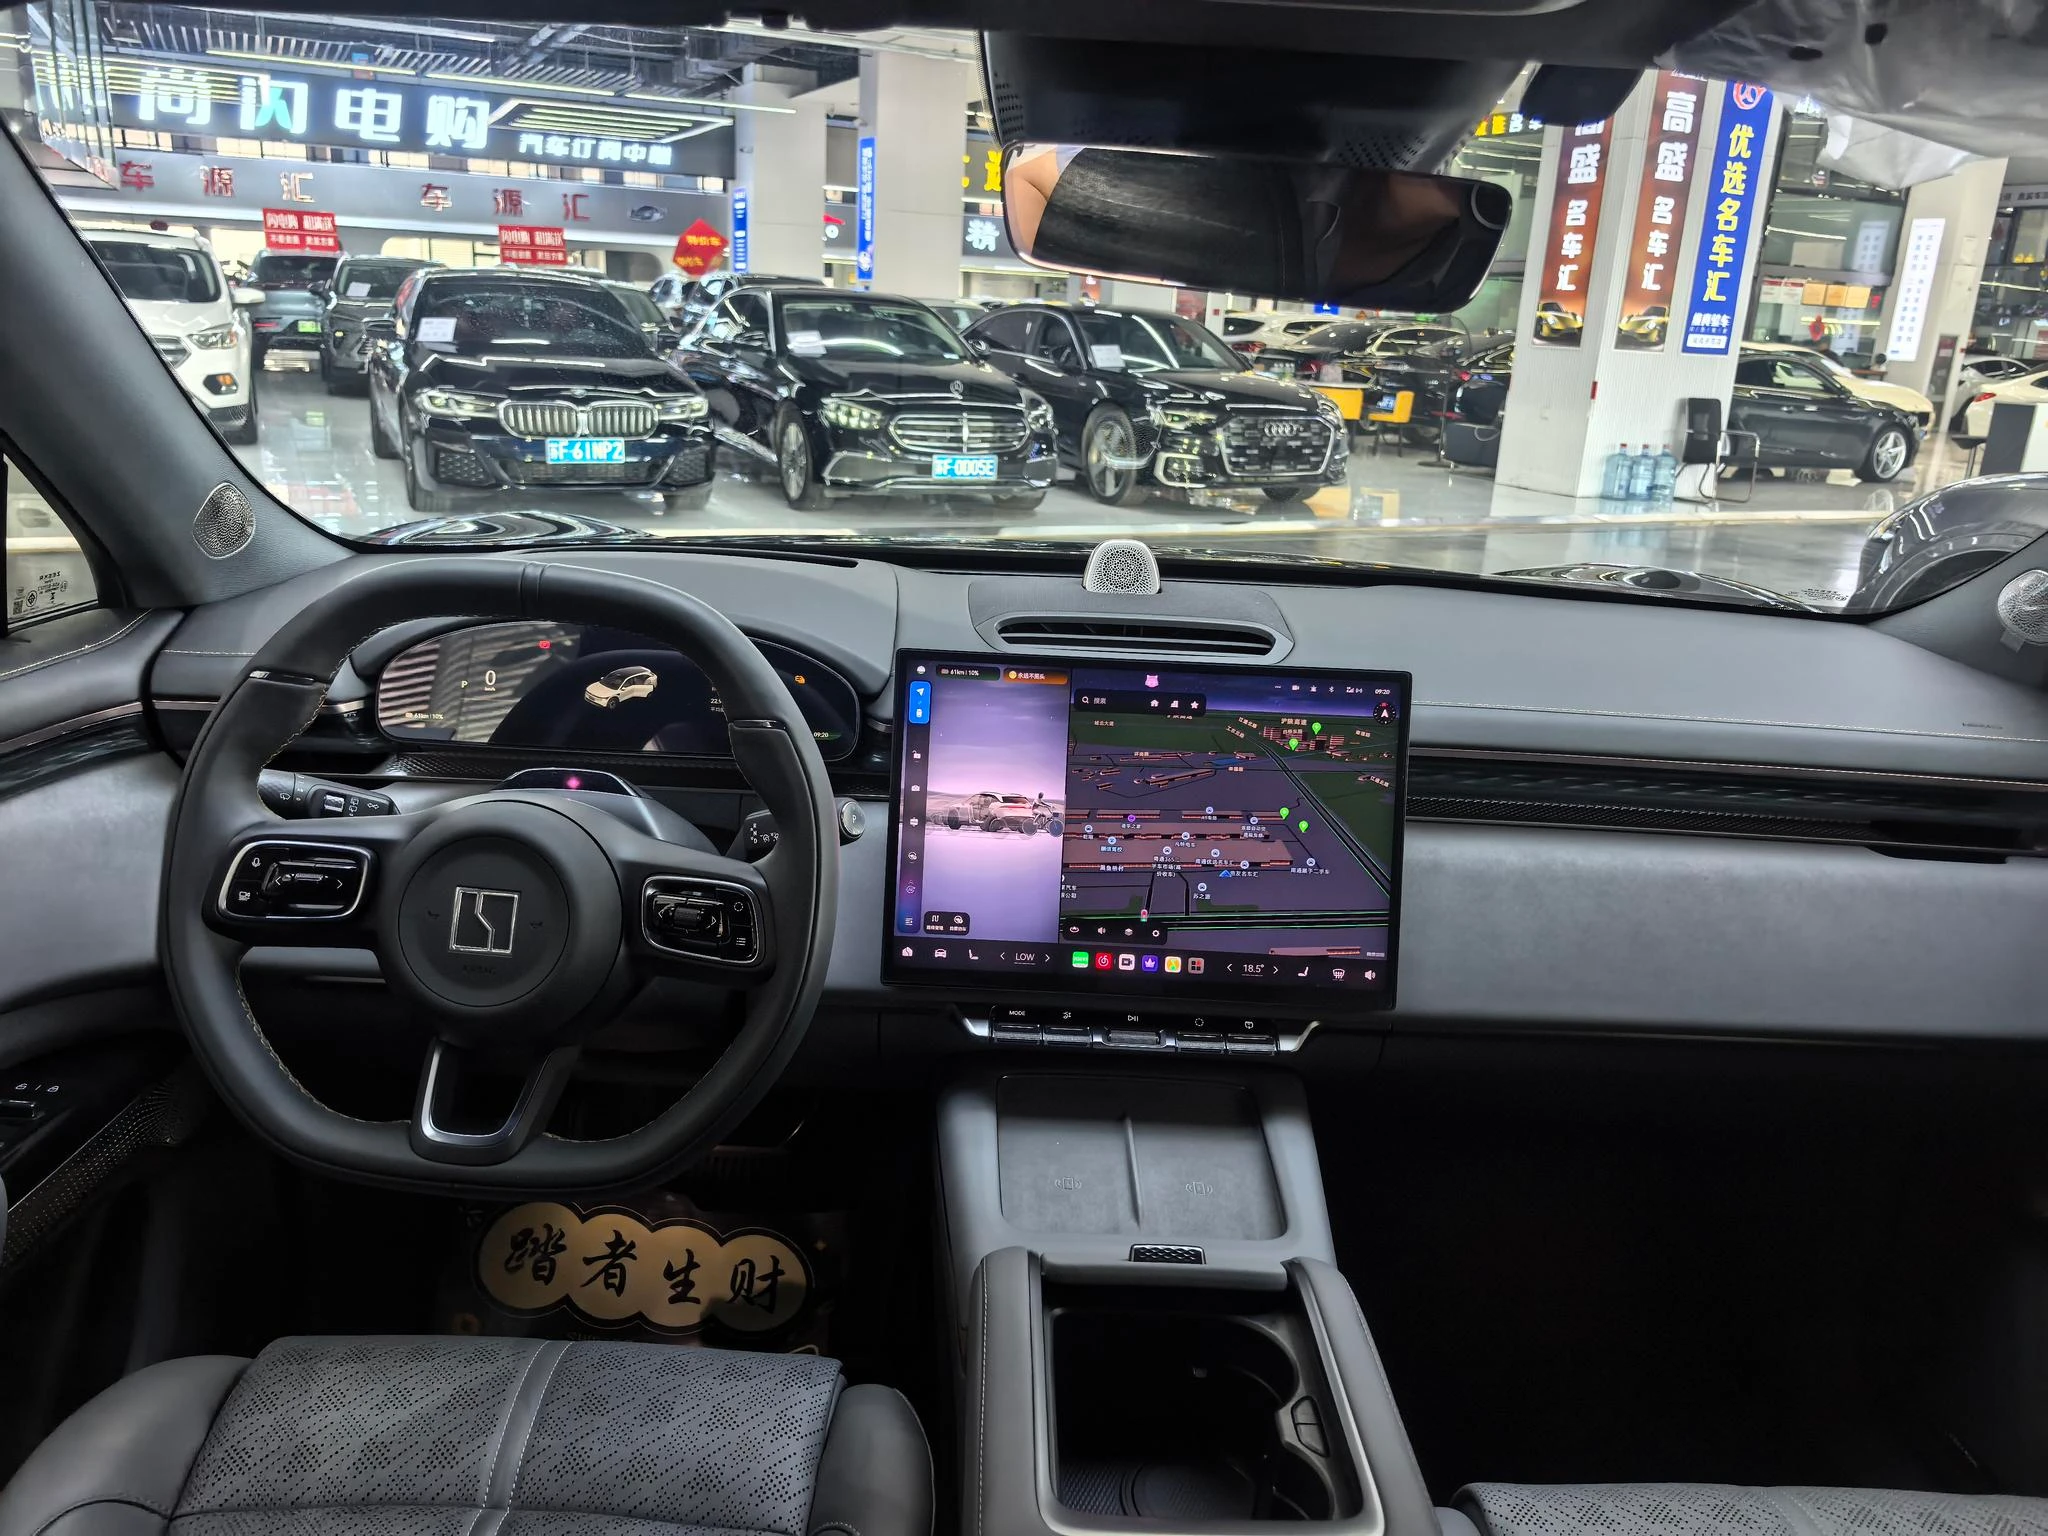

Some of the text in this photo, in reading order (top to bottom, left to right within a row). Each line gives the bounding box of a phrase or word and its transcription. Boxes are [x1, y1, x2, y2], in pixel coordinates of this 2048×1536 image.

[1640, 91, 1698, 291] 高盛名车汇
[1702, 124, 1755, 302] 优选名车汇
[461, 680, 468, 688] P
[485, 670, 496, 686] 0
[851, 815, 857, 823] P
[1015, 952, 1035, 961] LOW
[1242, 963, 1265, 973] 18.5°
[503, 1222, 786, 1314] 踏者生财
